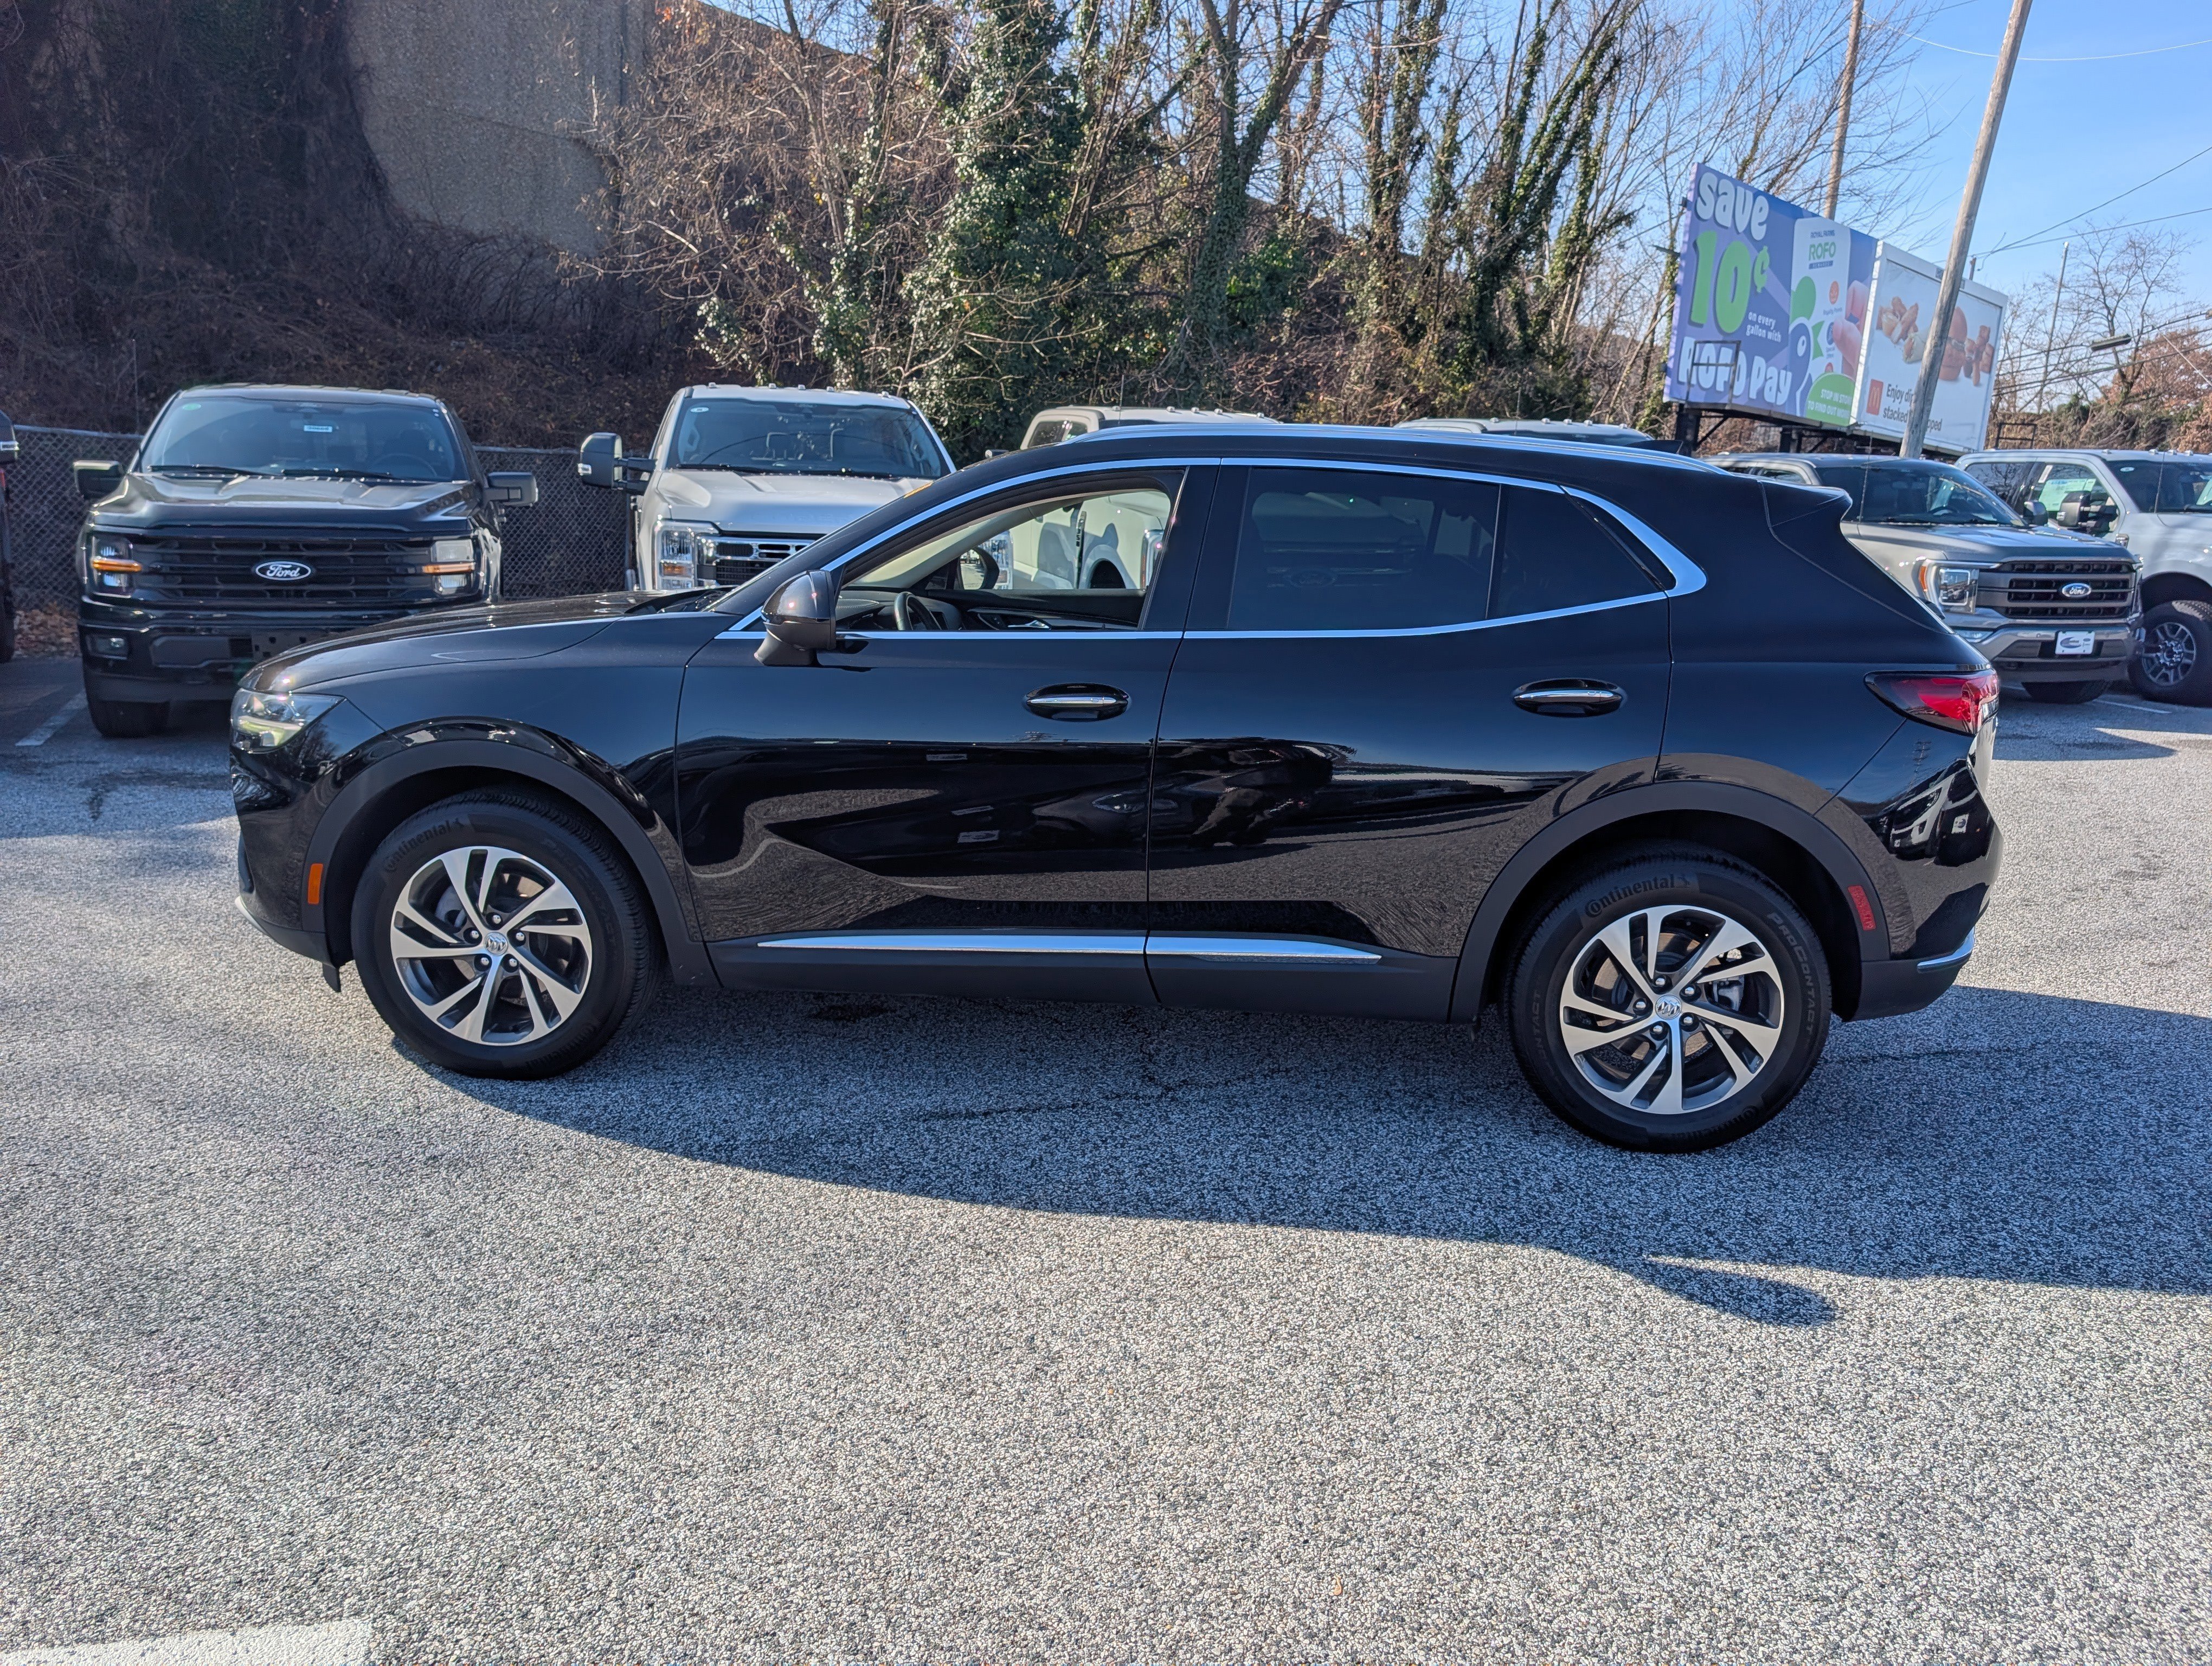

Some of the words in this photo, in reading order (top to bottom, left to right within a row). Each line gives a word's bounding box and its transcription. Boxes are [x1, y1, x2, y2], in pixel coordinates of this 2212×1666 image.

[1809, 241, 1836, 261] ROFO
[1748, 311, 1757, 322] on
[1758, 315, 1776, 330] every
[1746, 324, 1766, 338] gallon
[1767, 330, 1781, 342] with
[1679, 336, 1747, 396] ROFO
[1749, 355, 1792, 406] Pay
[1886, 383, 1905, 404] Enjoy
[1883, 406, 1908, 422] stacked
[267, 564, 300, 577] Ford
[2069, 586, 2085, 595] Ford
[1585, 874, 1675, 918] Continental
